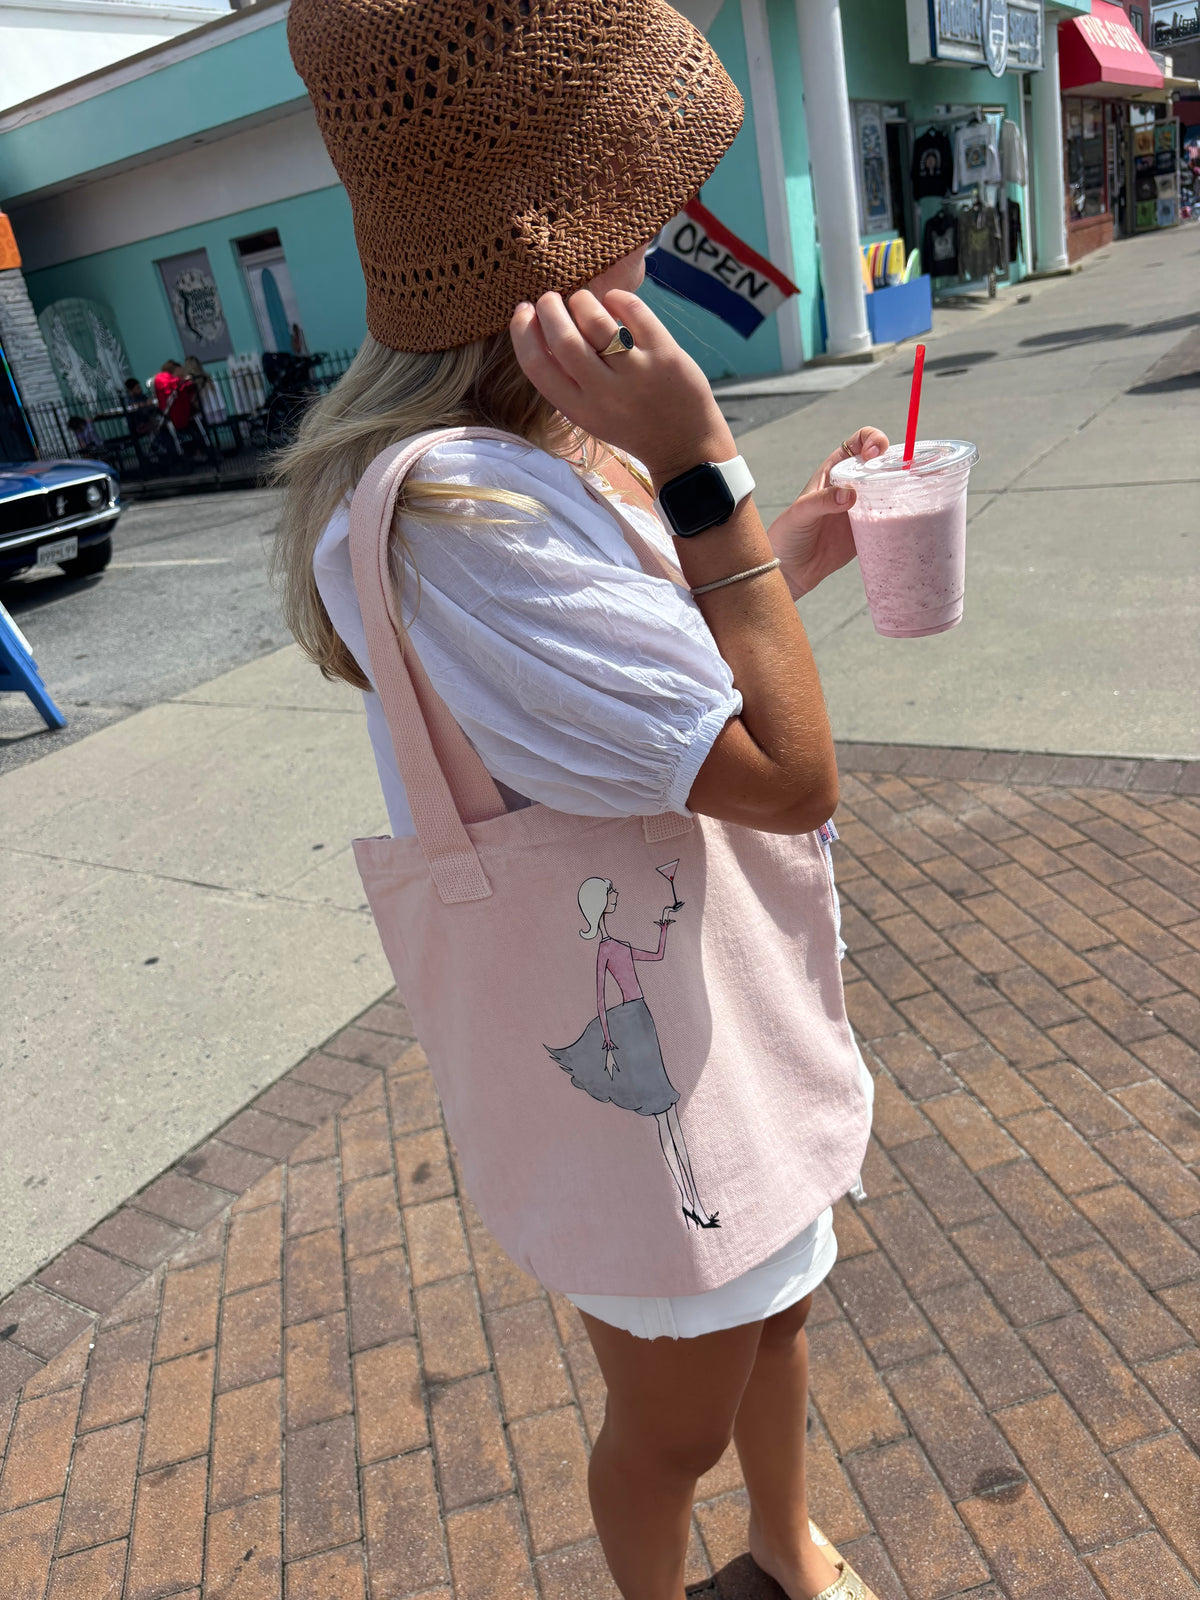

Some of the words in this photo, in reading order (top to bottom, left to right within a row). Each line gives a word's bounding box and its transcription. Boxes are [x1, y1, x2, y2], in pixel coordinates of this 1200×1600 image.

[1078, 14, 1117, 48] FIVE
[1104, 20, 1144, 55] GUYS
[673, 222, 769, 299] OPEN
